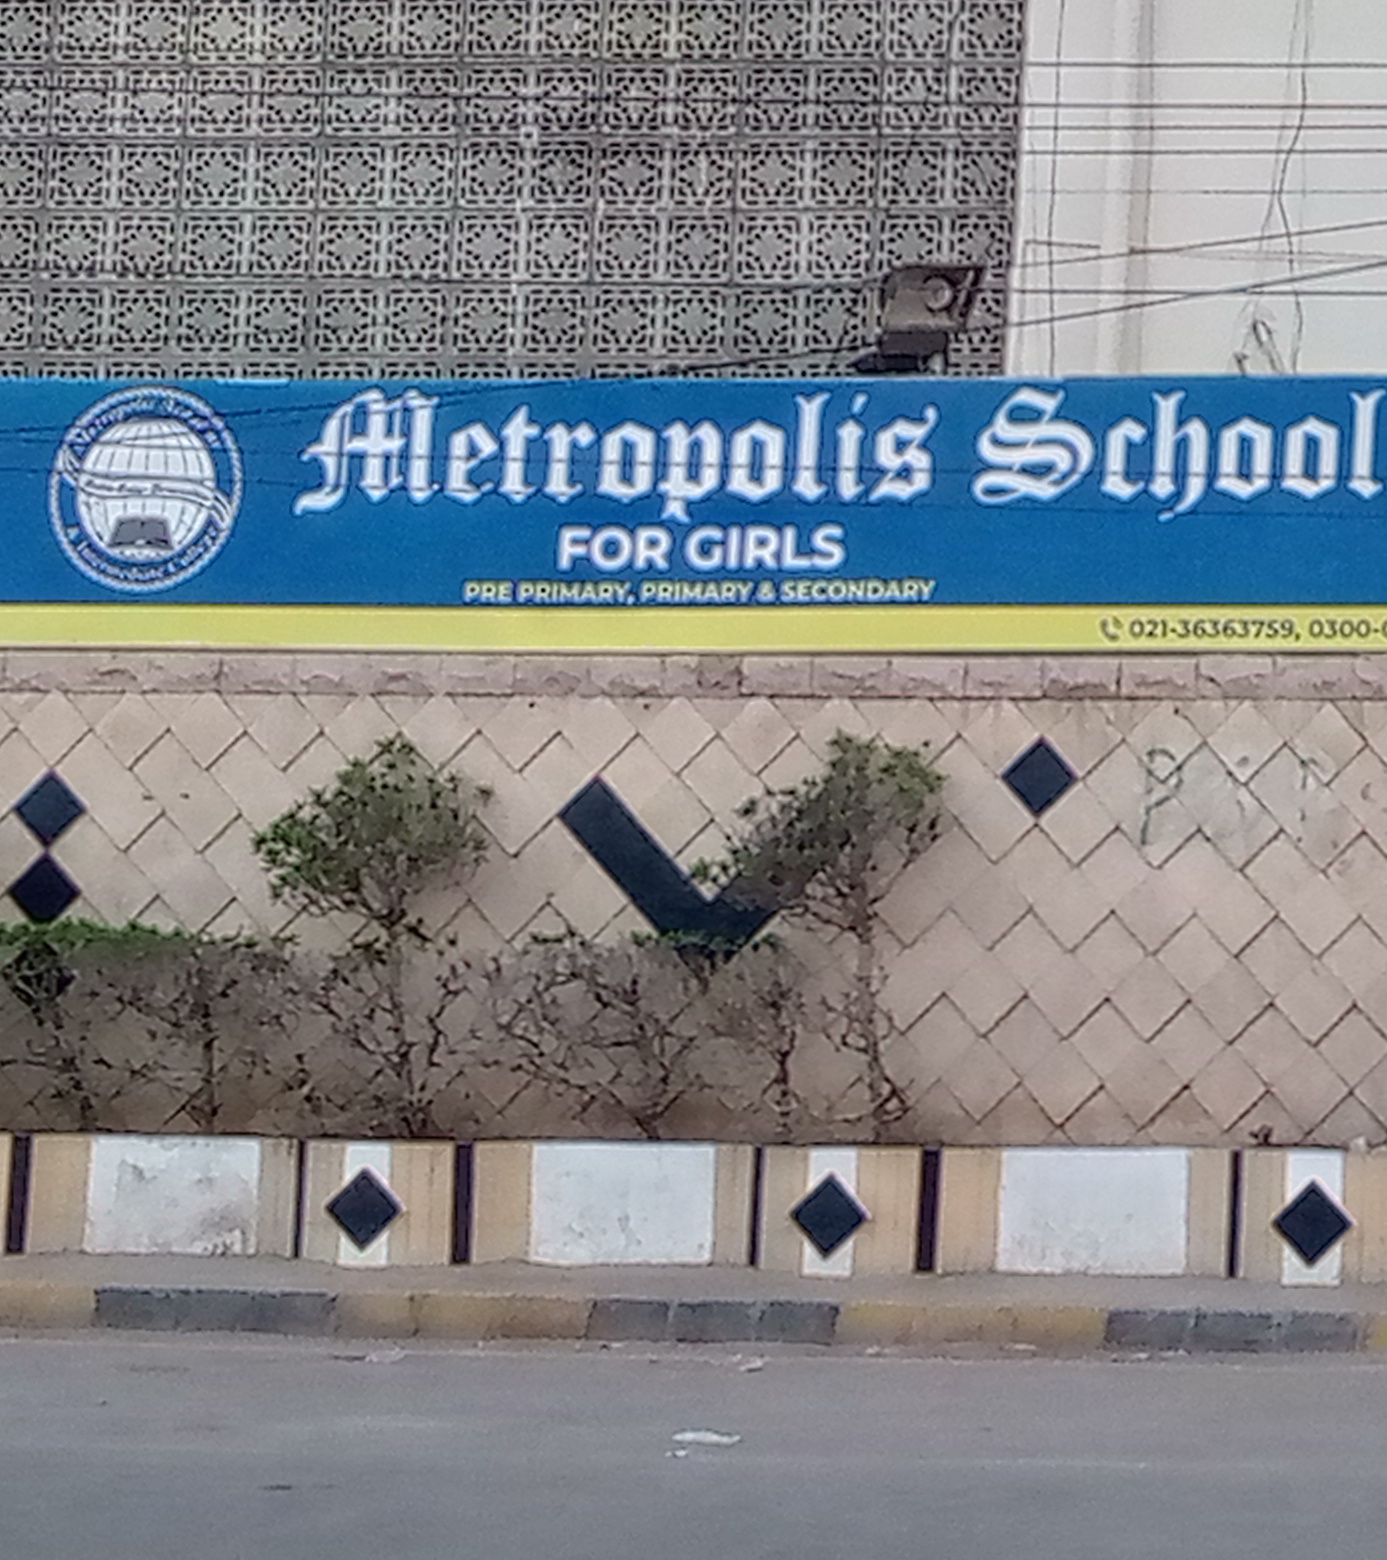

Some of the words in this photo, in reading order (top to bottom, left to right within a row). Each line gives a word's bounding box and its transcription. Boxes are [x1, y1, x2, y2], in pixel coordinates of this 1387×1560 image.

[294, 388, 938, 523] Metropolis
[971, 386, 1387, 521] School
[557, 525, 671, 571] FOR
[684, 524, 846, 570] GIRLS
[464, 580, 512, 603] PRE
[517, 580, 637, 605] PRIMARY,
[641, 580, 752, 603] PRIMARY
[756, 580, 777, 603] &
[780, 579, 936, 602] SECONDARY
[1129, 618, 1302, 640] 021-36363759,
